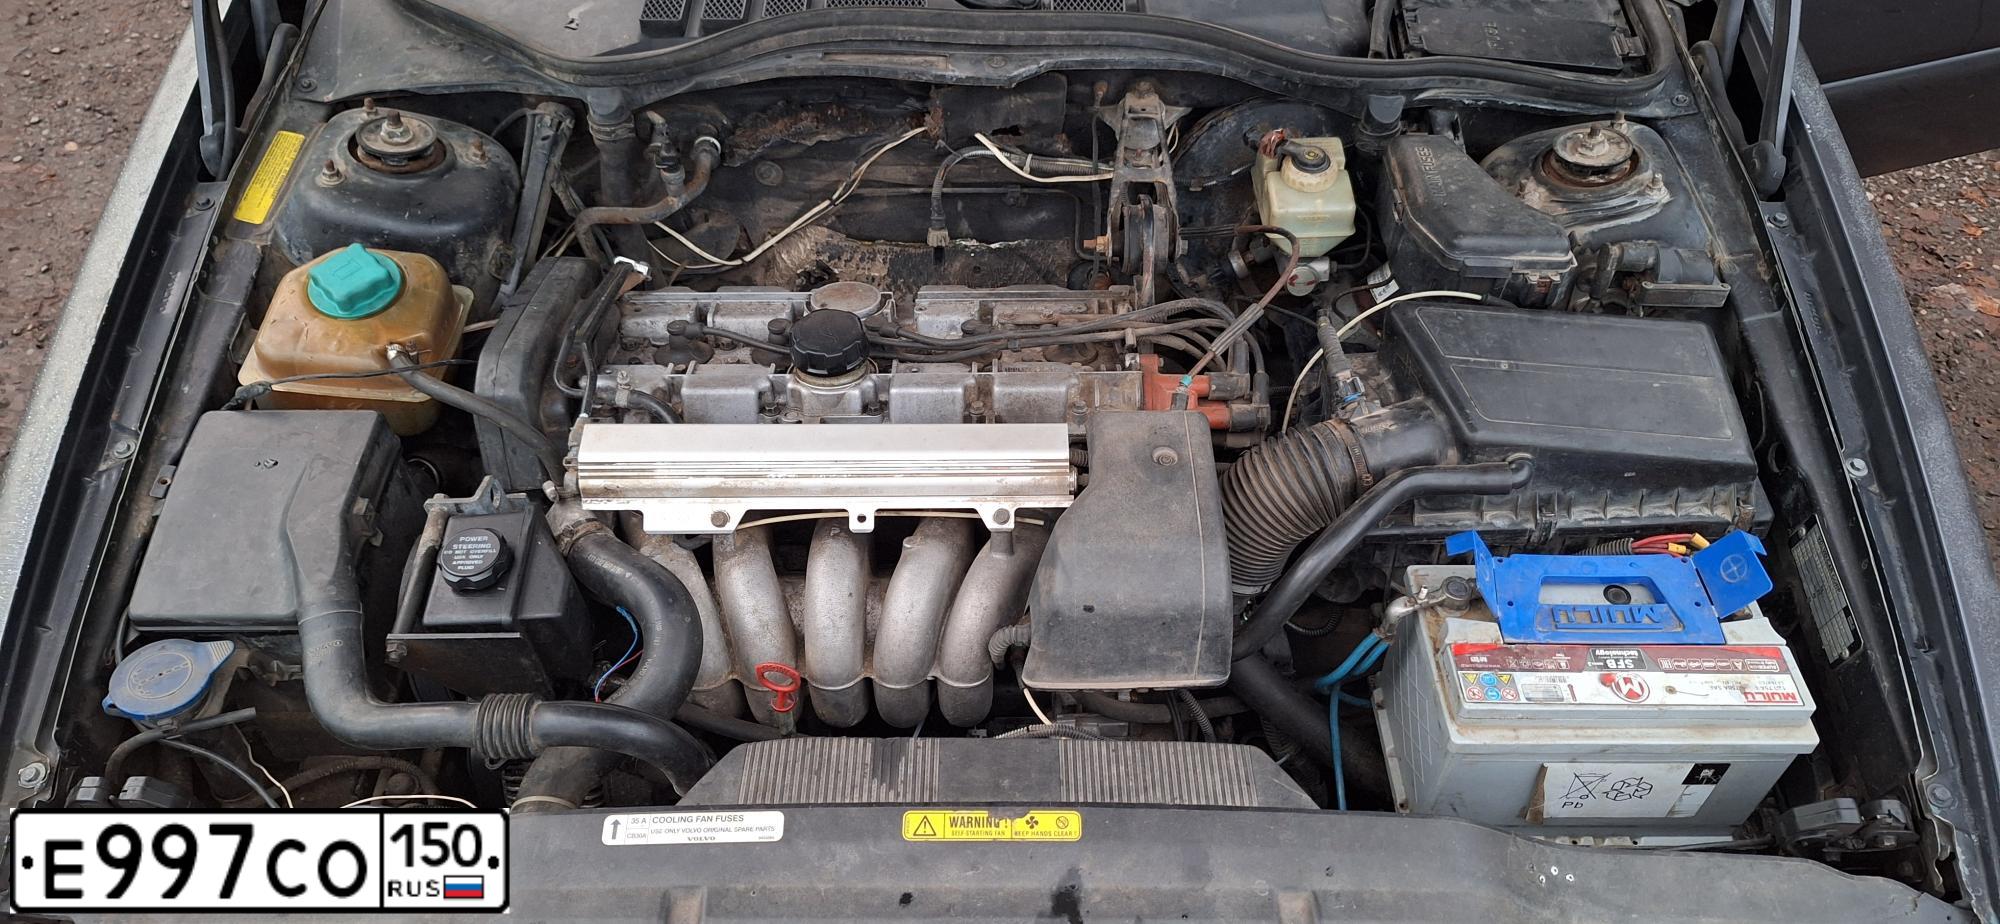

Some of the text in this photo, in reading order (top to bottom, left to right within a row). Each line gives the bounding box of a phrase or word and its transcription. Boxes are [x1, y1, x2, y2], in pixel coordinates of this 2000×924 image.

[1551, 605, 1661, 630] MUTLU
[1606, 659, 1635, 669] SFB
[1743, 691, 1798, 704] MUTLU
[1561, 801, 1584, 809] Pb
[630, 817, 647, 825] 35 A
[652, 814, 744, 824] COOLING FAN FUSES
[949, 816, 1000, 829] WARNING
